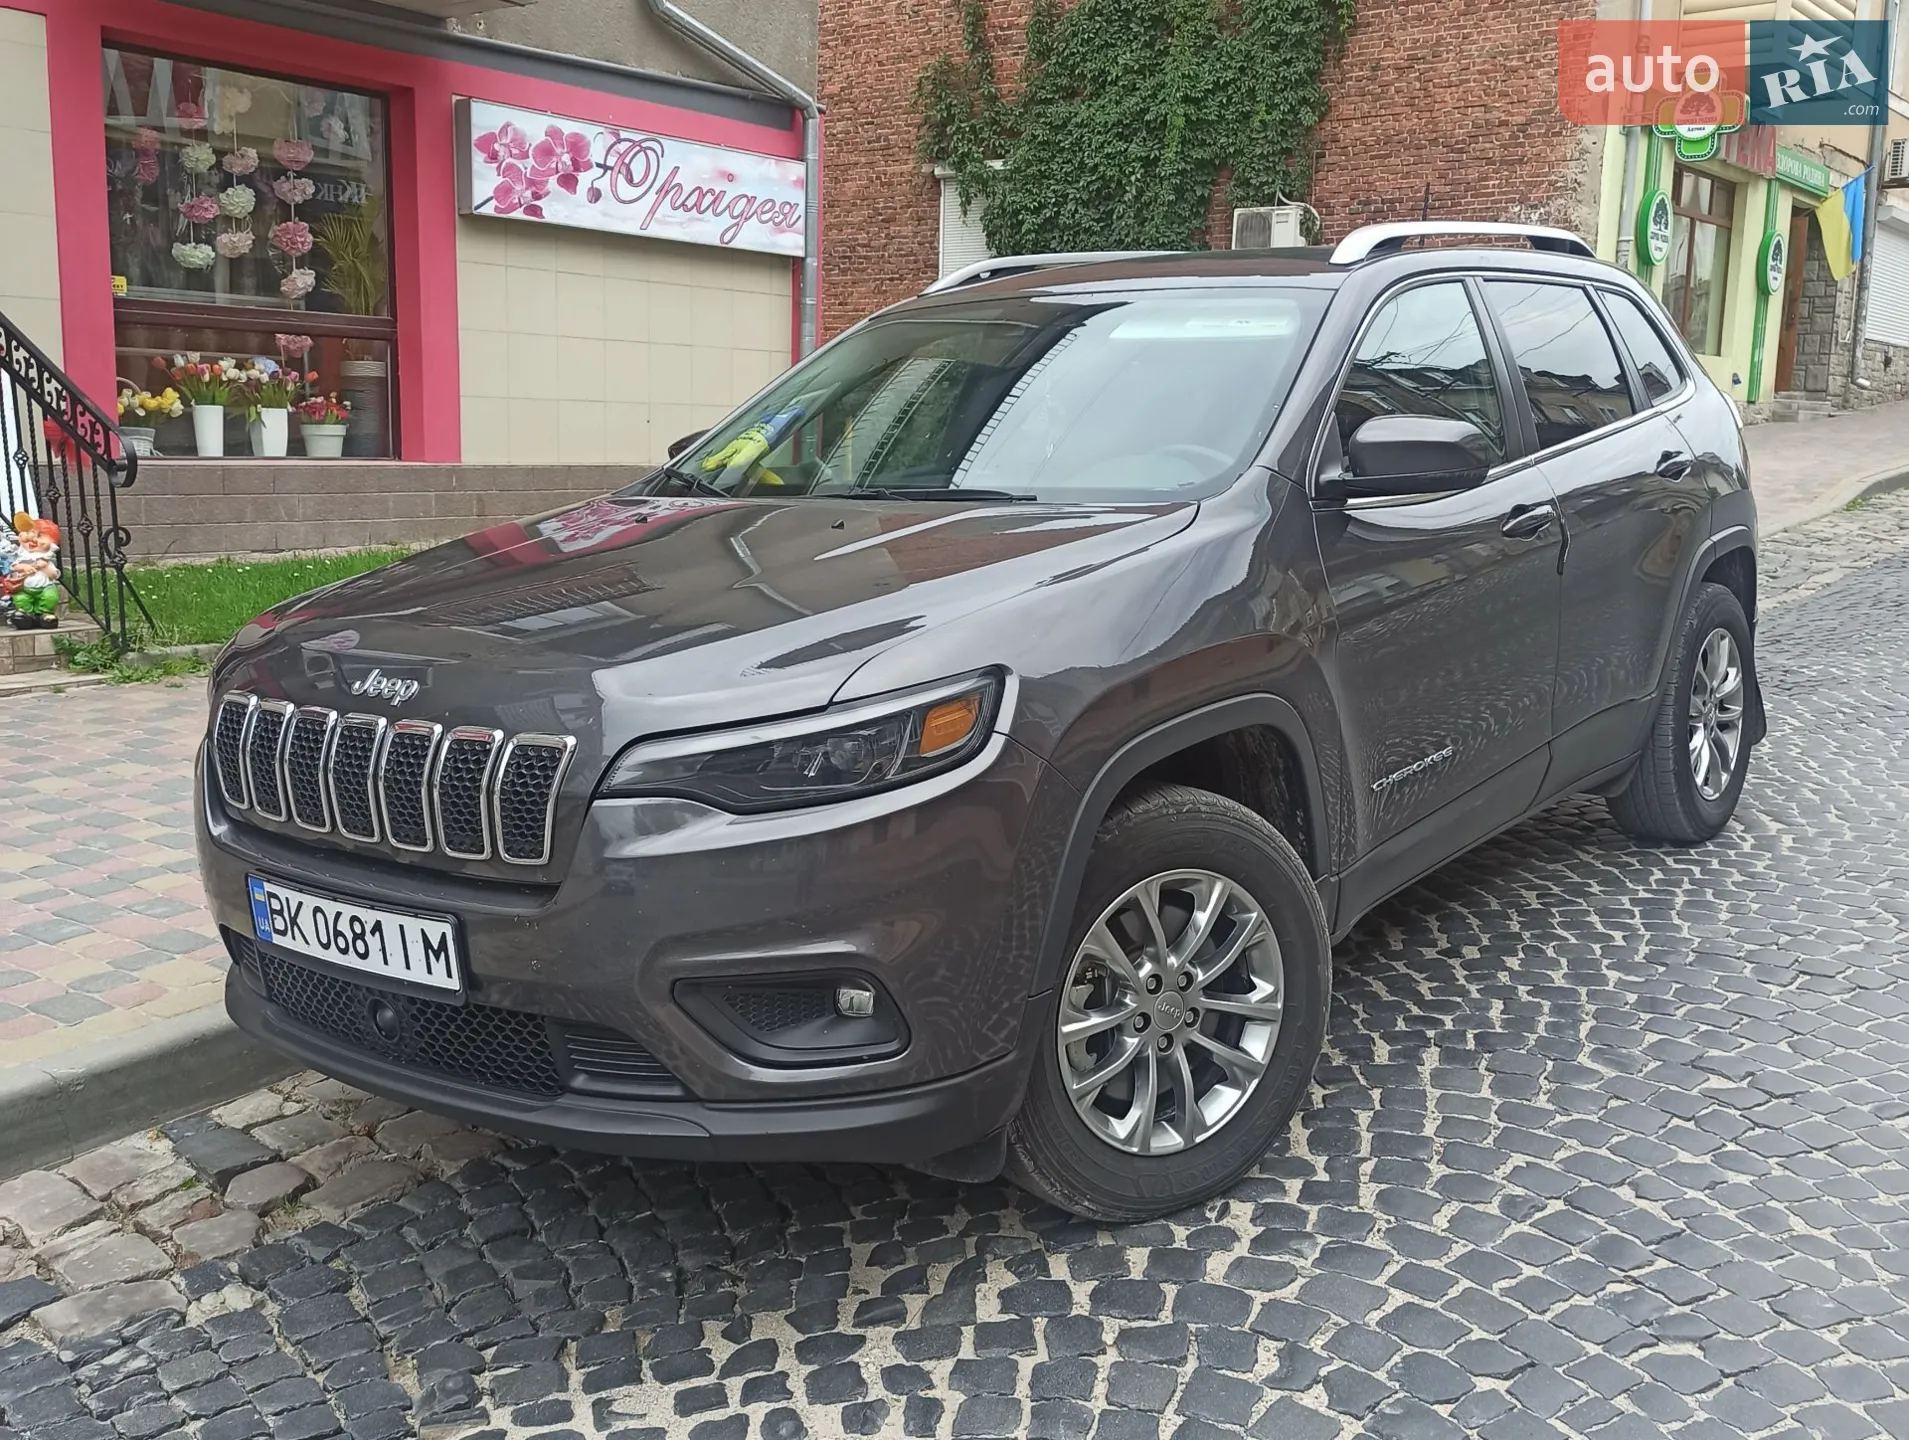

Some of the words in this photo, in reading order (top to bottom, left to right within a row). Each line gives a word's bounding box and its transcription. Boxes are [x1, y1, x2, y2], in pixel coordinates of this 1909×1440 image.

[1776, 152, 1802, 178] ЗДОРОВА
[351, 668, 420, 707] Jeep
[1371, 746, 1453, 791] CHEROKEE
[258, 916, 270, 932] UA
